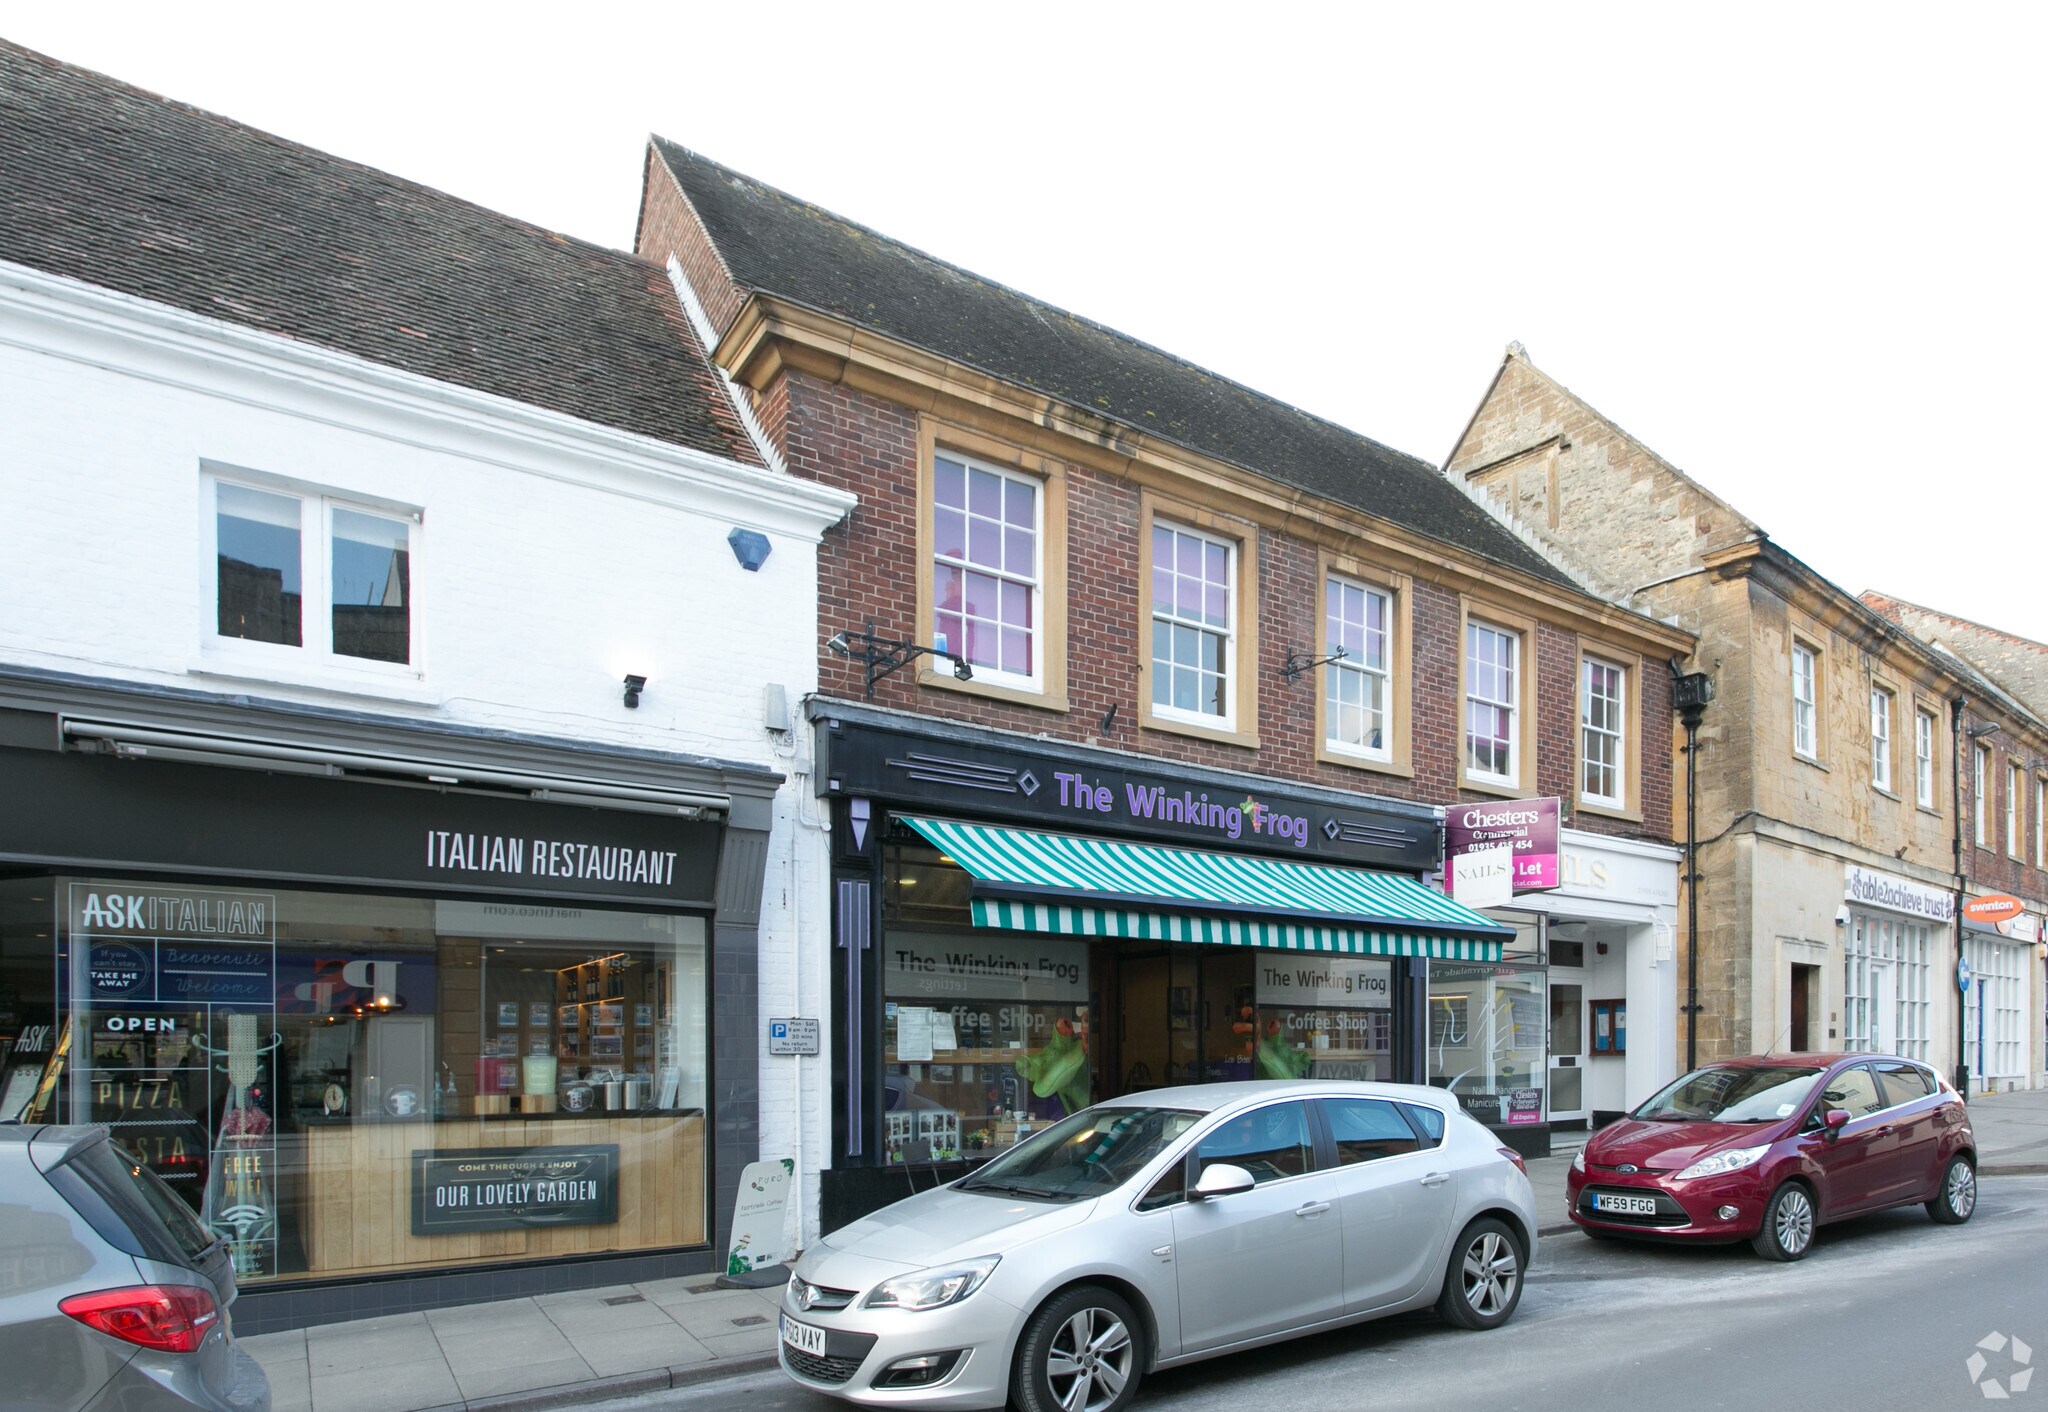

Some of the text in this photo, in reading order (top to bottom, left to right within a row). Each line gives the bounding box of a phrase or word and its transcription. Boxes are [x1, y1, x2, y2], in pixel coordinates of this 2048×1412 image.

[1053, 772, 1308, 847] The Winking Frog
[1463, 809, 1539, 829] Chesters
[1468, 842, 1494, 853] 01935
[1515, 840, 1533, 850] 454
[426, 830, 678, 886] ITALIAN RESTAURANT
[1457, 863, 1506, 882] NAILS
[1519, 862, 1542, 876] Let
[1862, 874, 1945, 917] able2achieve trust
[82, 893, 265, 935] ASK ITALIAN
[1969, 900, 2014, 912] swinton
[90, 971, 138, 980] TAKE ME
[896, 950, 1079, 984] The Winking Frog
[97, 980, 130, 988] AWAY
[174, 978, 260, 995] Welcome
[1263, 968, 1386, 994] The Winking Frog
[106, 1017, 176, 1033] OPEN
[999, 1007, 1046, 1033] Shop
[1286, 1013, 1369, 1034] Coffee Shop
[14, 1025, 51, 1053] ASK
[775, 1025, 785, 1036] P
[100, 1081, 182, 1111] PIZZA
[1472, 1086, 1486, 1095] Nail
[119, 1136, 187, 1164] STA
[224, 1156, 262, 1174] FREE
[458, 1164, 486, 1172] COME
[489, 1162, 536, 1170] THROUGH
[548, 1160, 578, 1169] ENJOY
[224, 1179, 262, 1196] WIFI
[435, 1179, 597, 1208] OUR LOVELY GARDEN
[1600, 1196, 1653, 1212] WF59 FGG
[801, 1327, 821, 1350] VAY
